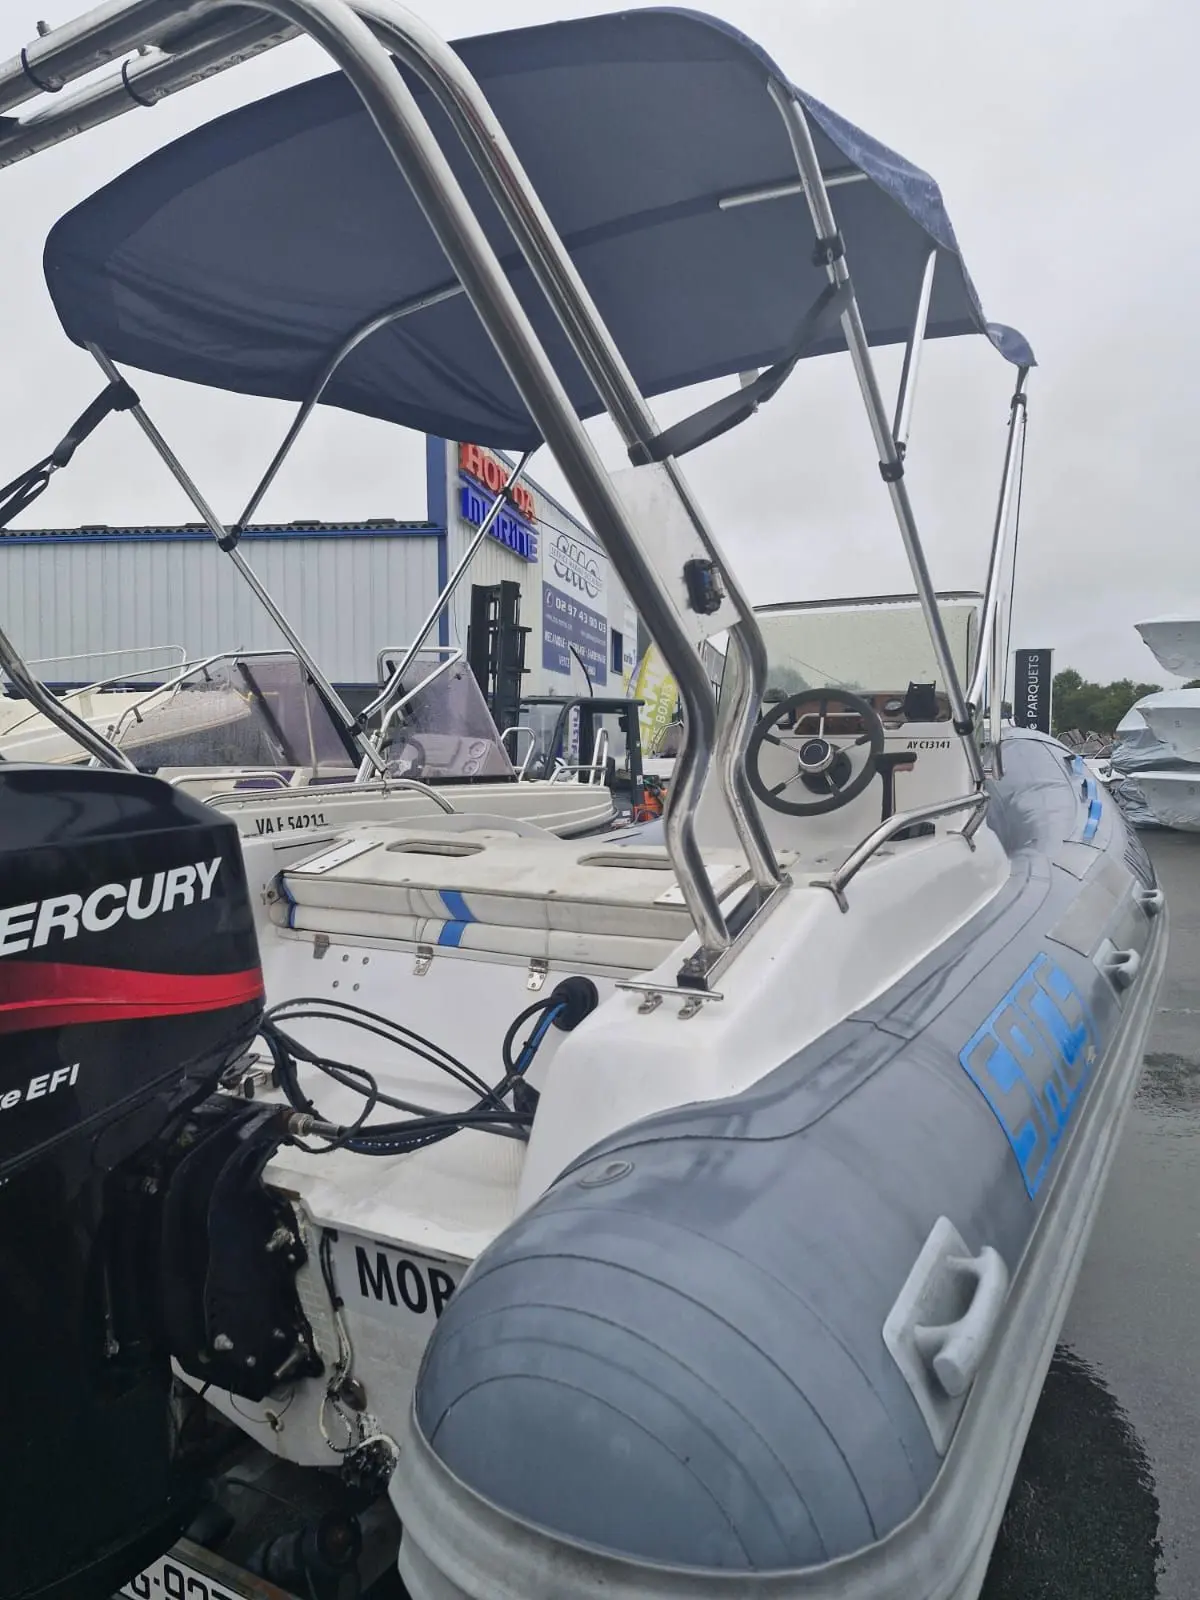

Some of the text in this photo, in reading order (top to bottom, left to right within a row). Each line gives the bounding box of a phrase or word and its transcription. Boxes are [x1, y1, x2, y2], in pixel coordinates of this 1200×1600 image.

[555, 597, 567, 613] 02
[567, 603, 577, 618] 97
[1027, 655, 1039, 718] PARQUETS
[255, 818, 274, 835] VA
[26, 1063, 80, 1101] EFI
